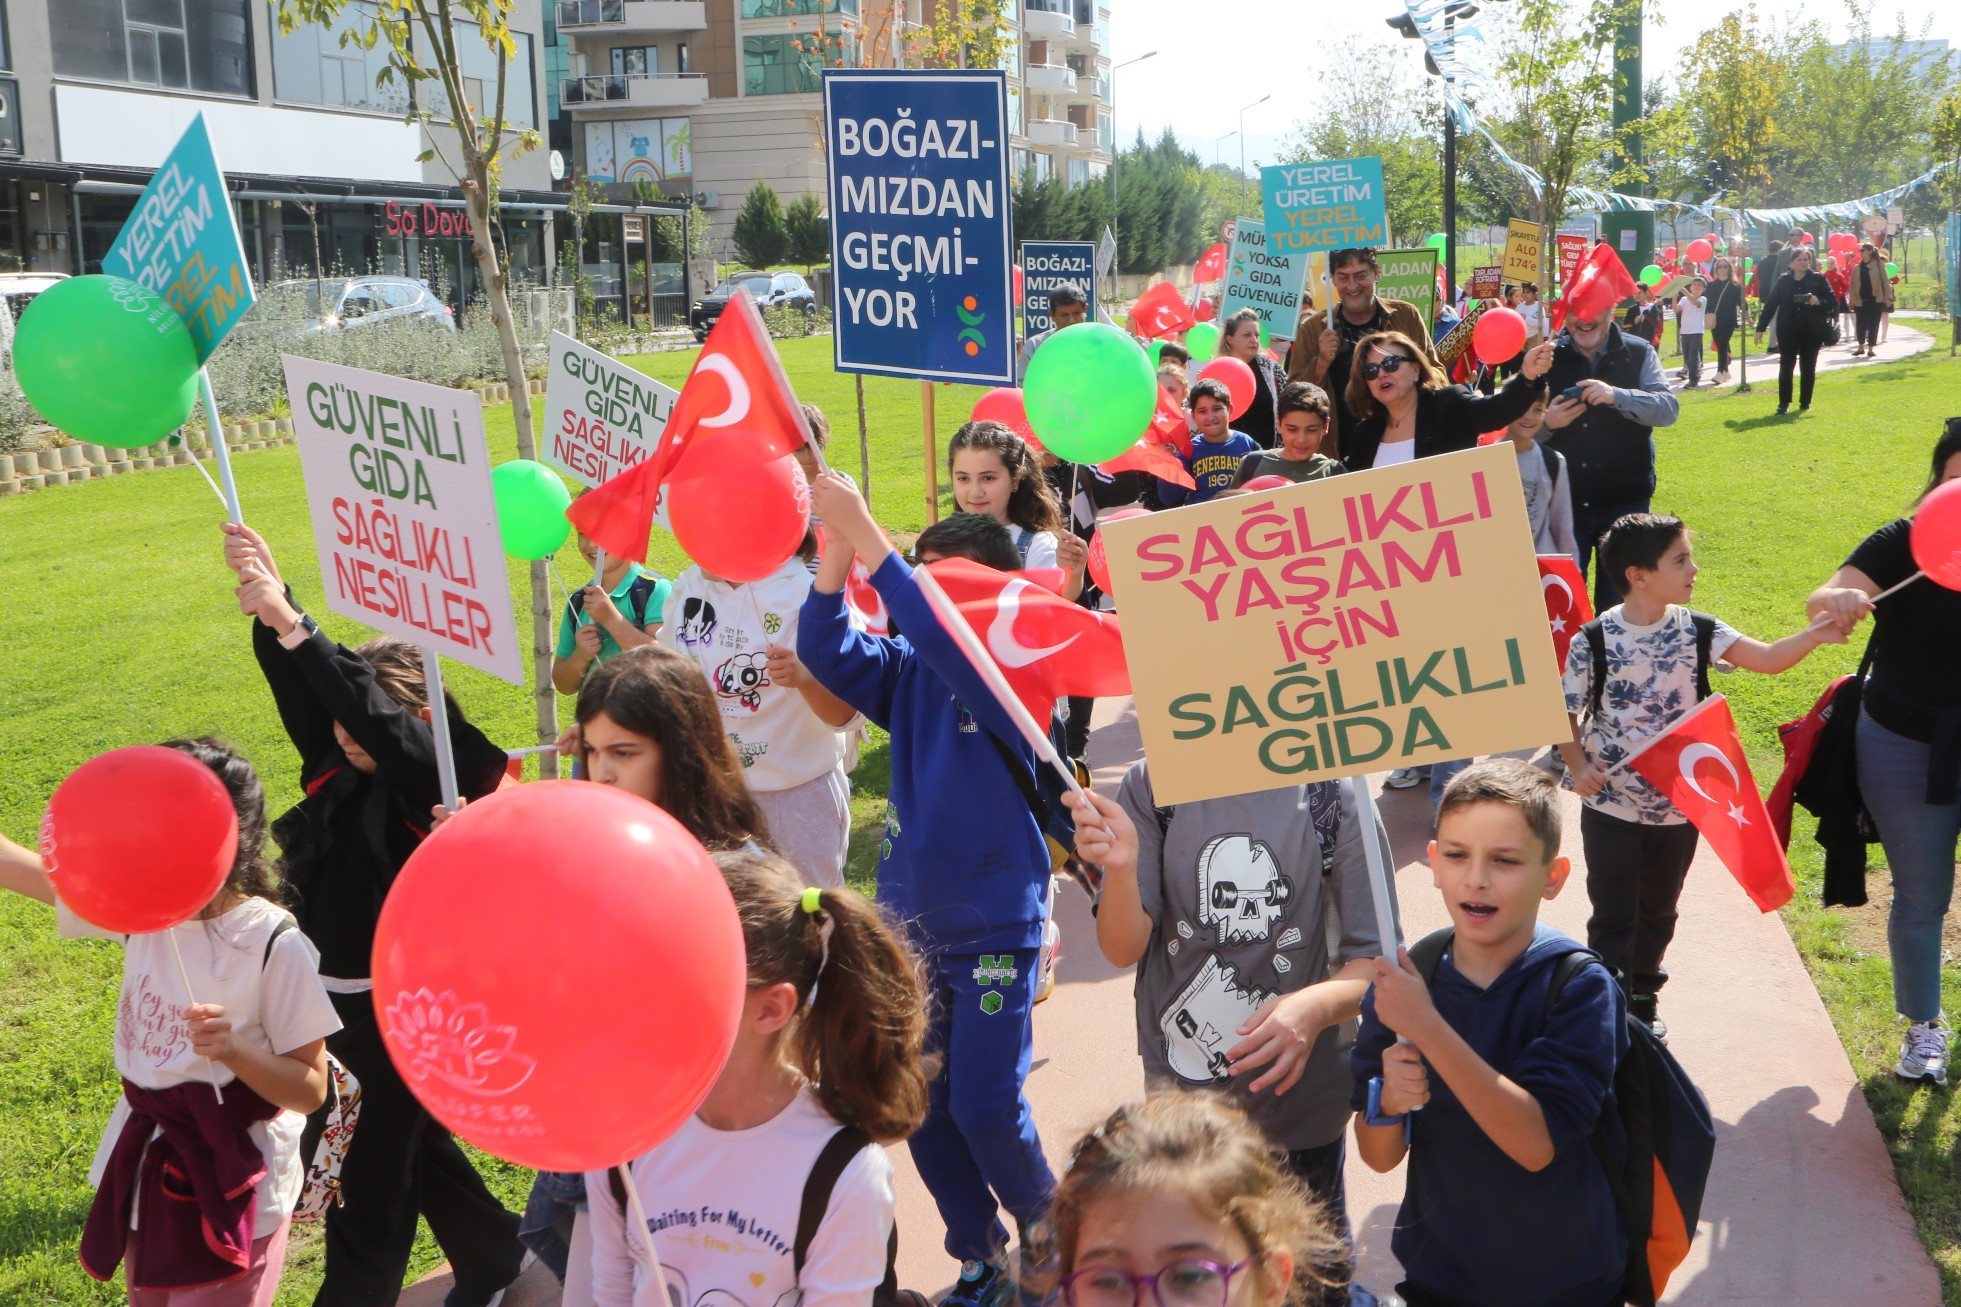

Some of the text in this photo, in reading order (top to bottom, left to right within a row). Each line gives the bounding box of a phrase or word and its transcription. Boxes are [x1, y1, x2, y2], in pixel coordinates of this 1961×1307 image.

[838, 107, 995, 160] BOĞAZI-
[841, 175, 994, 219] MIZDAN
[1275, 183, 1372, 208] ÜRETİM
[1281, 164, 1362, 187] YEREL
[118, 162, 195, 275] YEREL
[136, 183, 213, 296] RETİM
[386, 200, 415, 236] So
[1271, 223, 1382, 250] TÜKETİM
[1285, 205, 1366, 228] YEREL
[842, 227, 979, 281] GEÇMİ-
[1026, 254, 1091, 272] BOĞAZI-
[1249, 251, 1290, 270] YOKSA
[1509, 257, 1537, 272] 174'e
[1516, 244, 1537, 257] ALO
[165, 248, 219, 314] REL
[1228, 284, 1298, 308] GÜVENLİĞİ
[1250, 270, 1281, 287] GIDA
[843, 287, 918, 329] YOR
[306, 381, 467, 465] GÜVENLİ
[585, 389, 644, 440] GIDA
[349, 443, 438, 511] GIDA
[332, 497, 477, 589] SAĞLIKLI
[1136, 471, 1493, 582] SAĞLIKLI
[1180, 529, 1462, 623] YAŞAM
[333, 551, 494, 656] NESİLLER
[1276, 600, 1400, 665] İÇİN
[1167, 637, 1526, 740] SAĞLIKLI
[1258, 707, 1452, 775] GIDA
[701, 1206, 724, 1225] For
[726, 1210, 748, 1234] My
[749, 1218, 793, 1256] Letter
